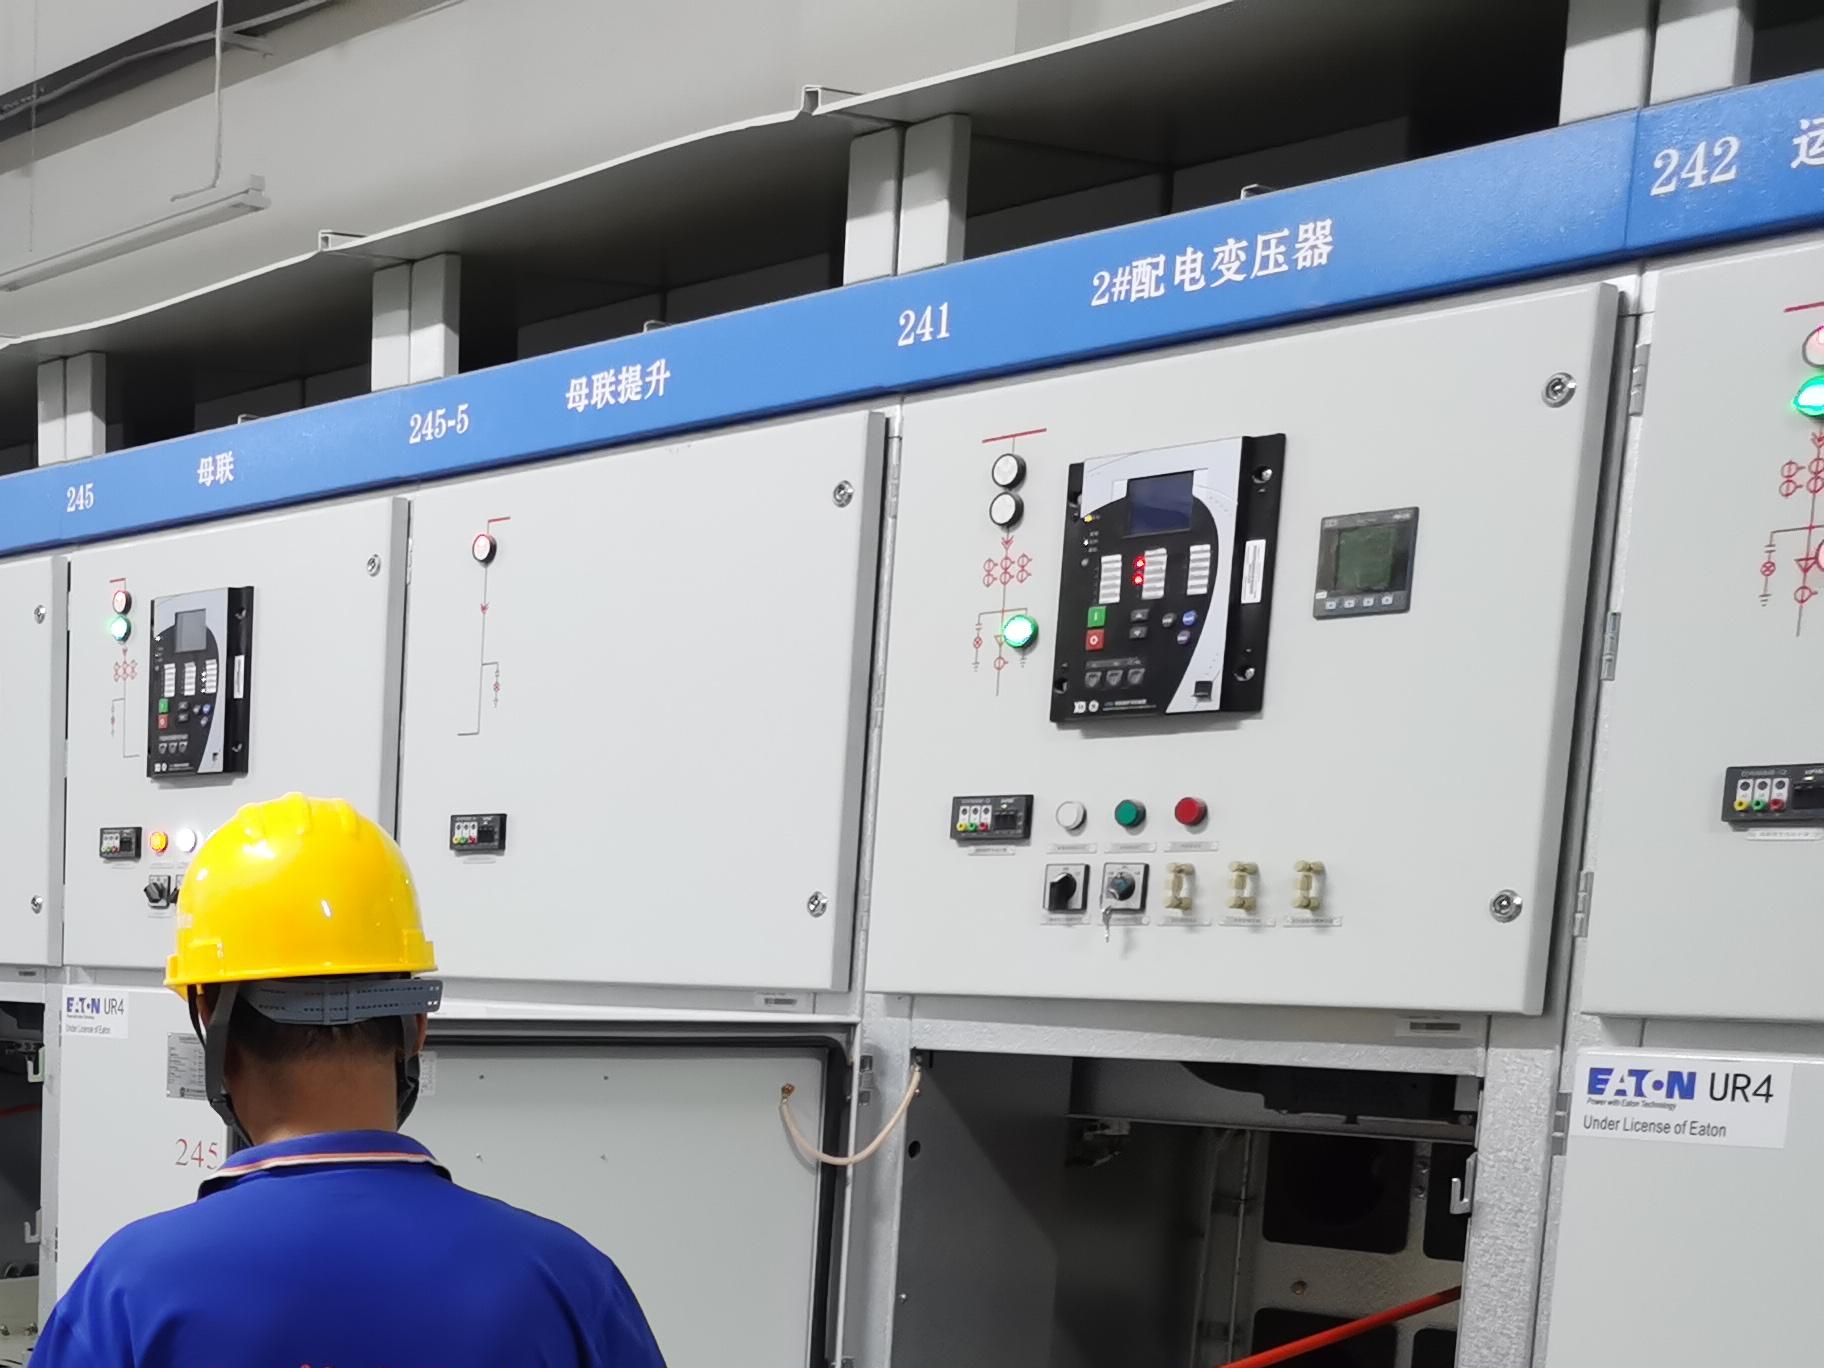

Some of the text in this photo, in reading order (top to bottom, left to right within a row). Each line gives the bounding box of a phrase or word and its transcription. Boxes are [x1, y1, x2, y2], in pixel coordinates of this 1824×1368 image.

[1650, 136, 1740, 196] 242
[898, 217, 1334, 346] 241 2#配电变压器
[409, 357, 672, 444] 245-5 母联提升
[66, 450, 234, 513] 245 母联
[103, 997, 125, 1015] UR4
[1587, 1067, 1775, 1104] EATON UR4
[1583, 1114, 1727, 1138] Under License of Eaton
[175, 1138, 219, 1170] 245
